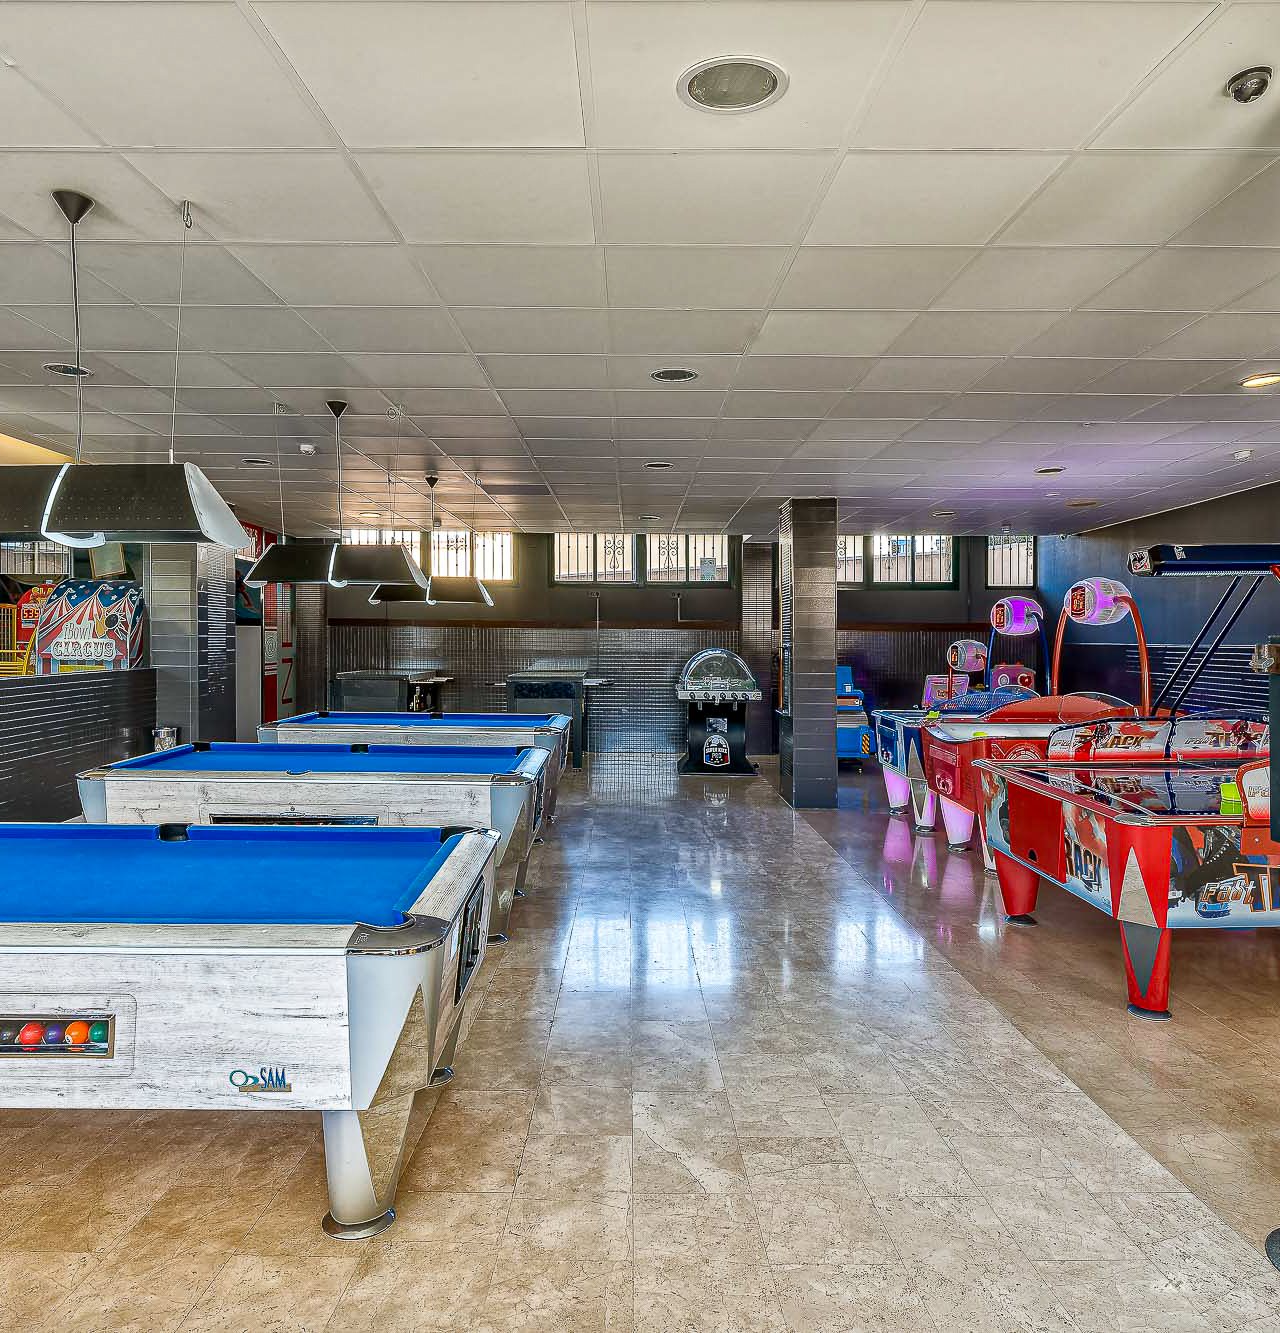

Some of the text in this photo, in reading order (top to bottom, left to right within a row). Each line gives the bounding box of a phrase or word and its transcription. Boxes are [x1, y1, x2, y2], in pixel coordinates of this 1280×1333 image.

[53, 641, 114, 658] CIRCUS
[1200, 879, 1258, 906] Fast
[260, 1067, 287, 1089] SAM
